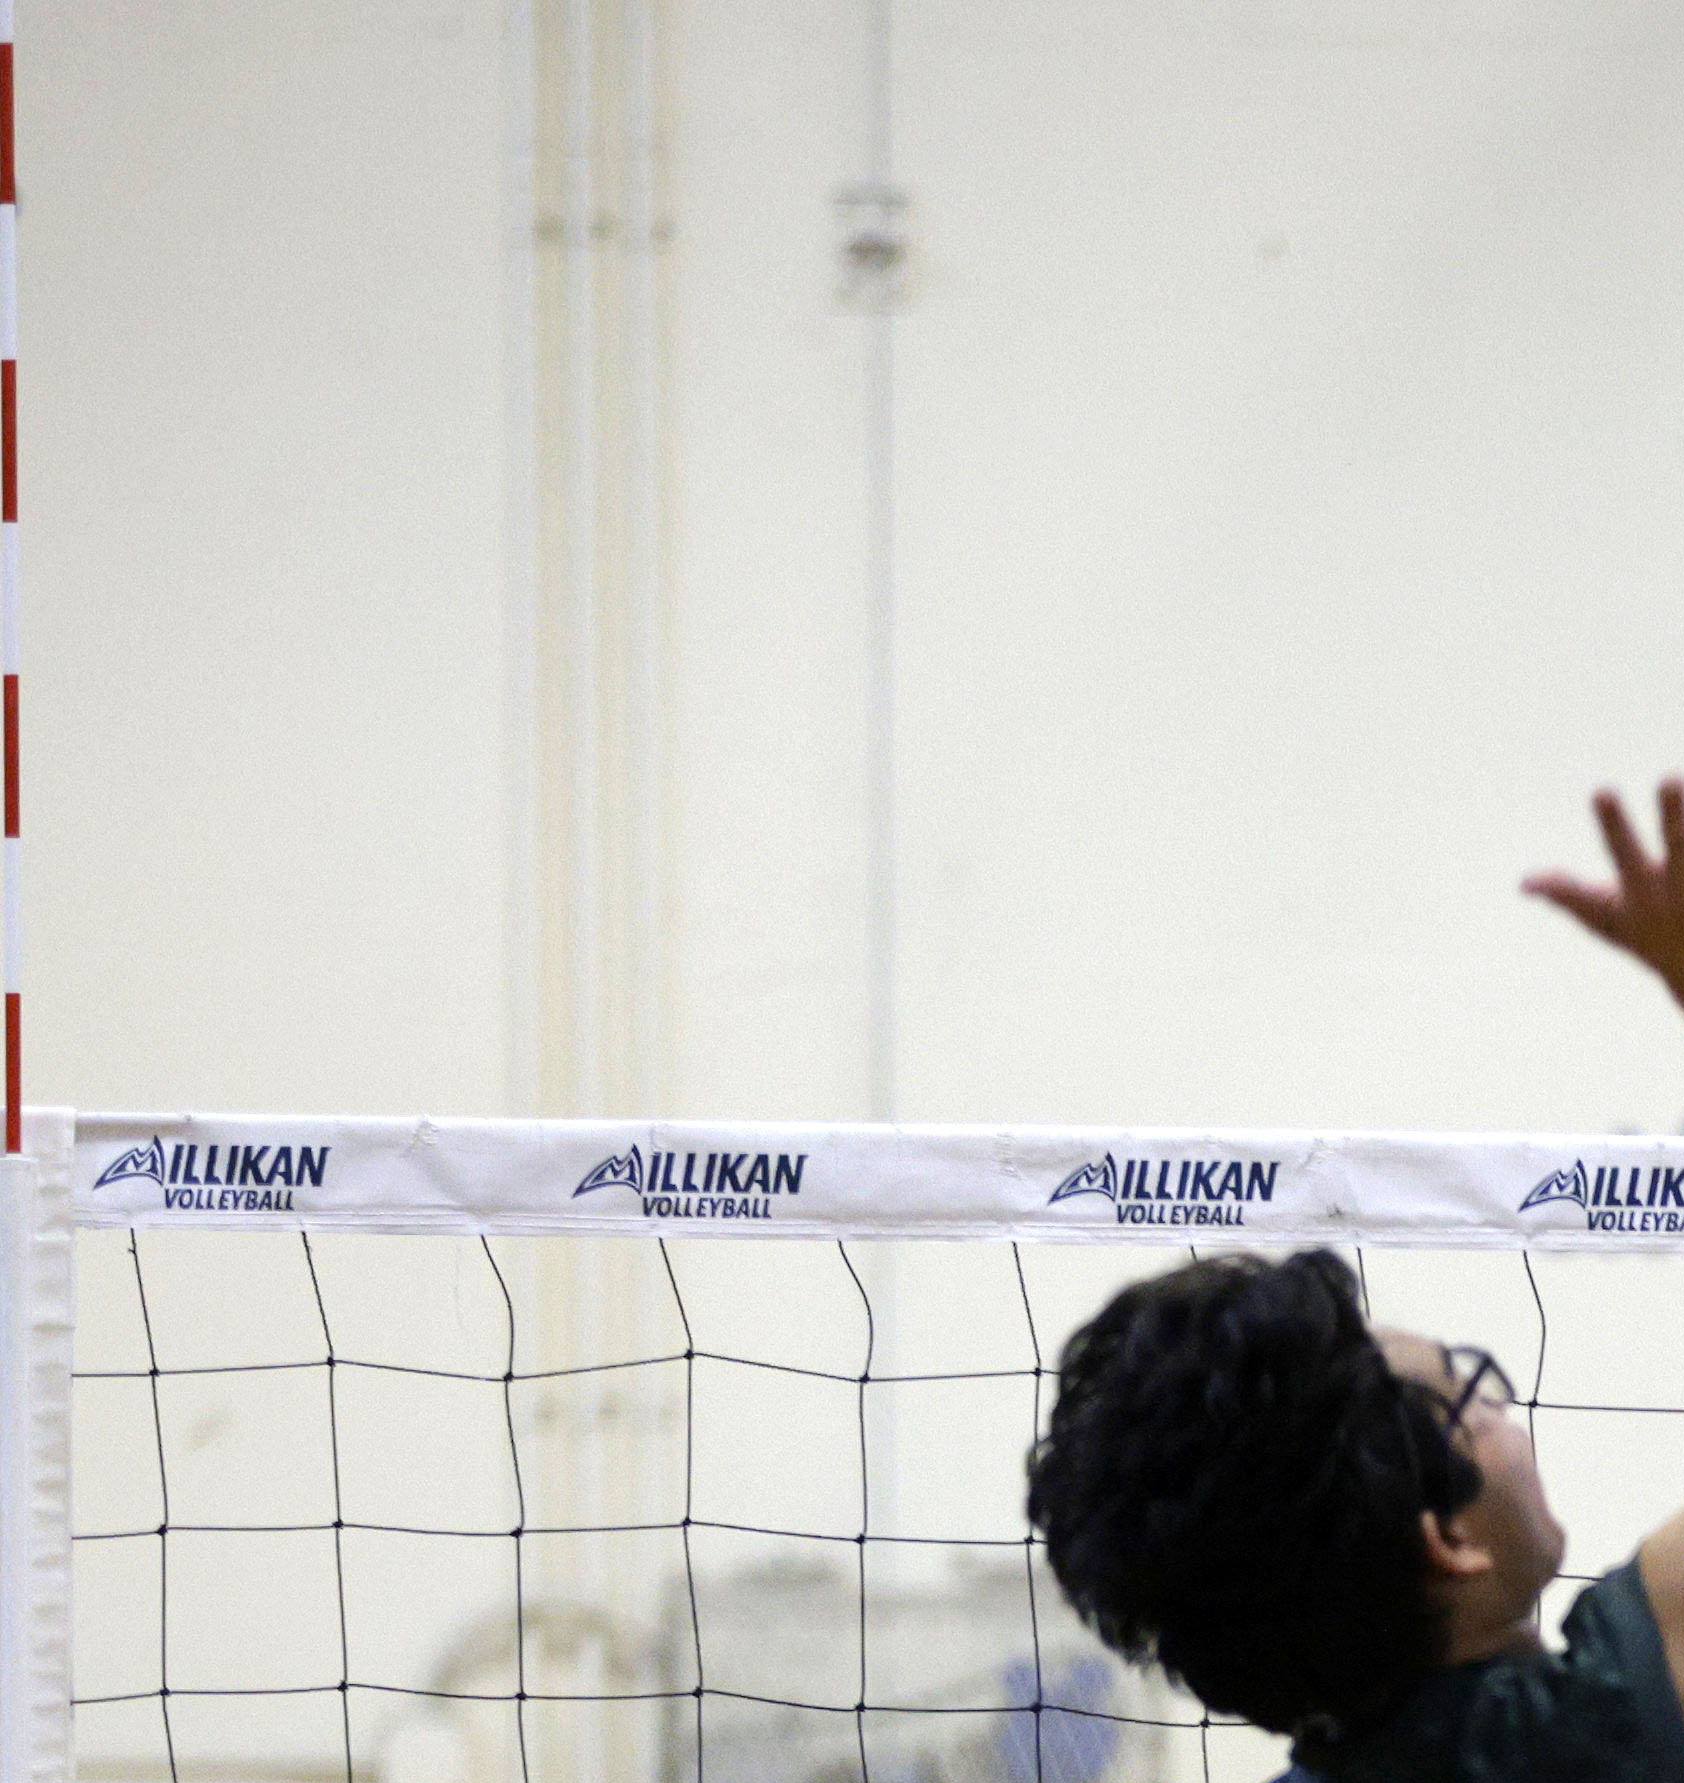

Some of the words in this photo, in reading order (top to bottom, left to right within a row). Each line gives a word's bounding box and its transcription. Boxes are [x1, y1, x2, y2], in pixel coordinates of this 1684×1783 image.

[165, 1187, 294, 1211] VOLLEYBALL
[642, 1197, 772, 1219] VOLLEYBALL
[1116, 1204, 1245, 1225] VOLLEYBALL
